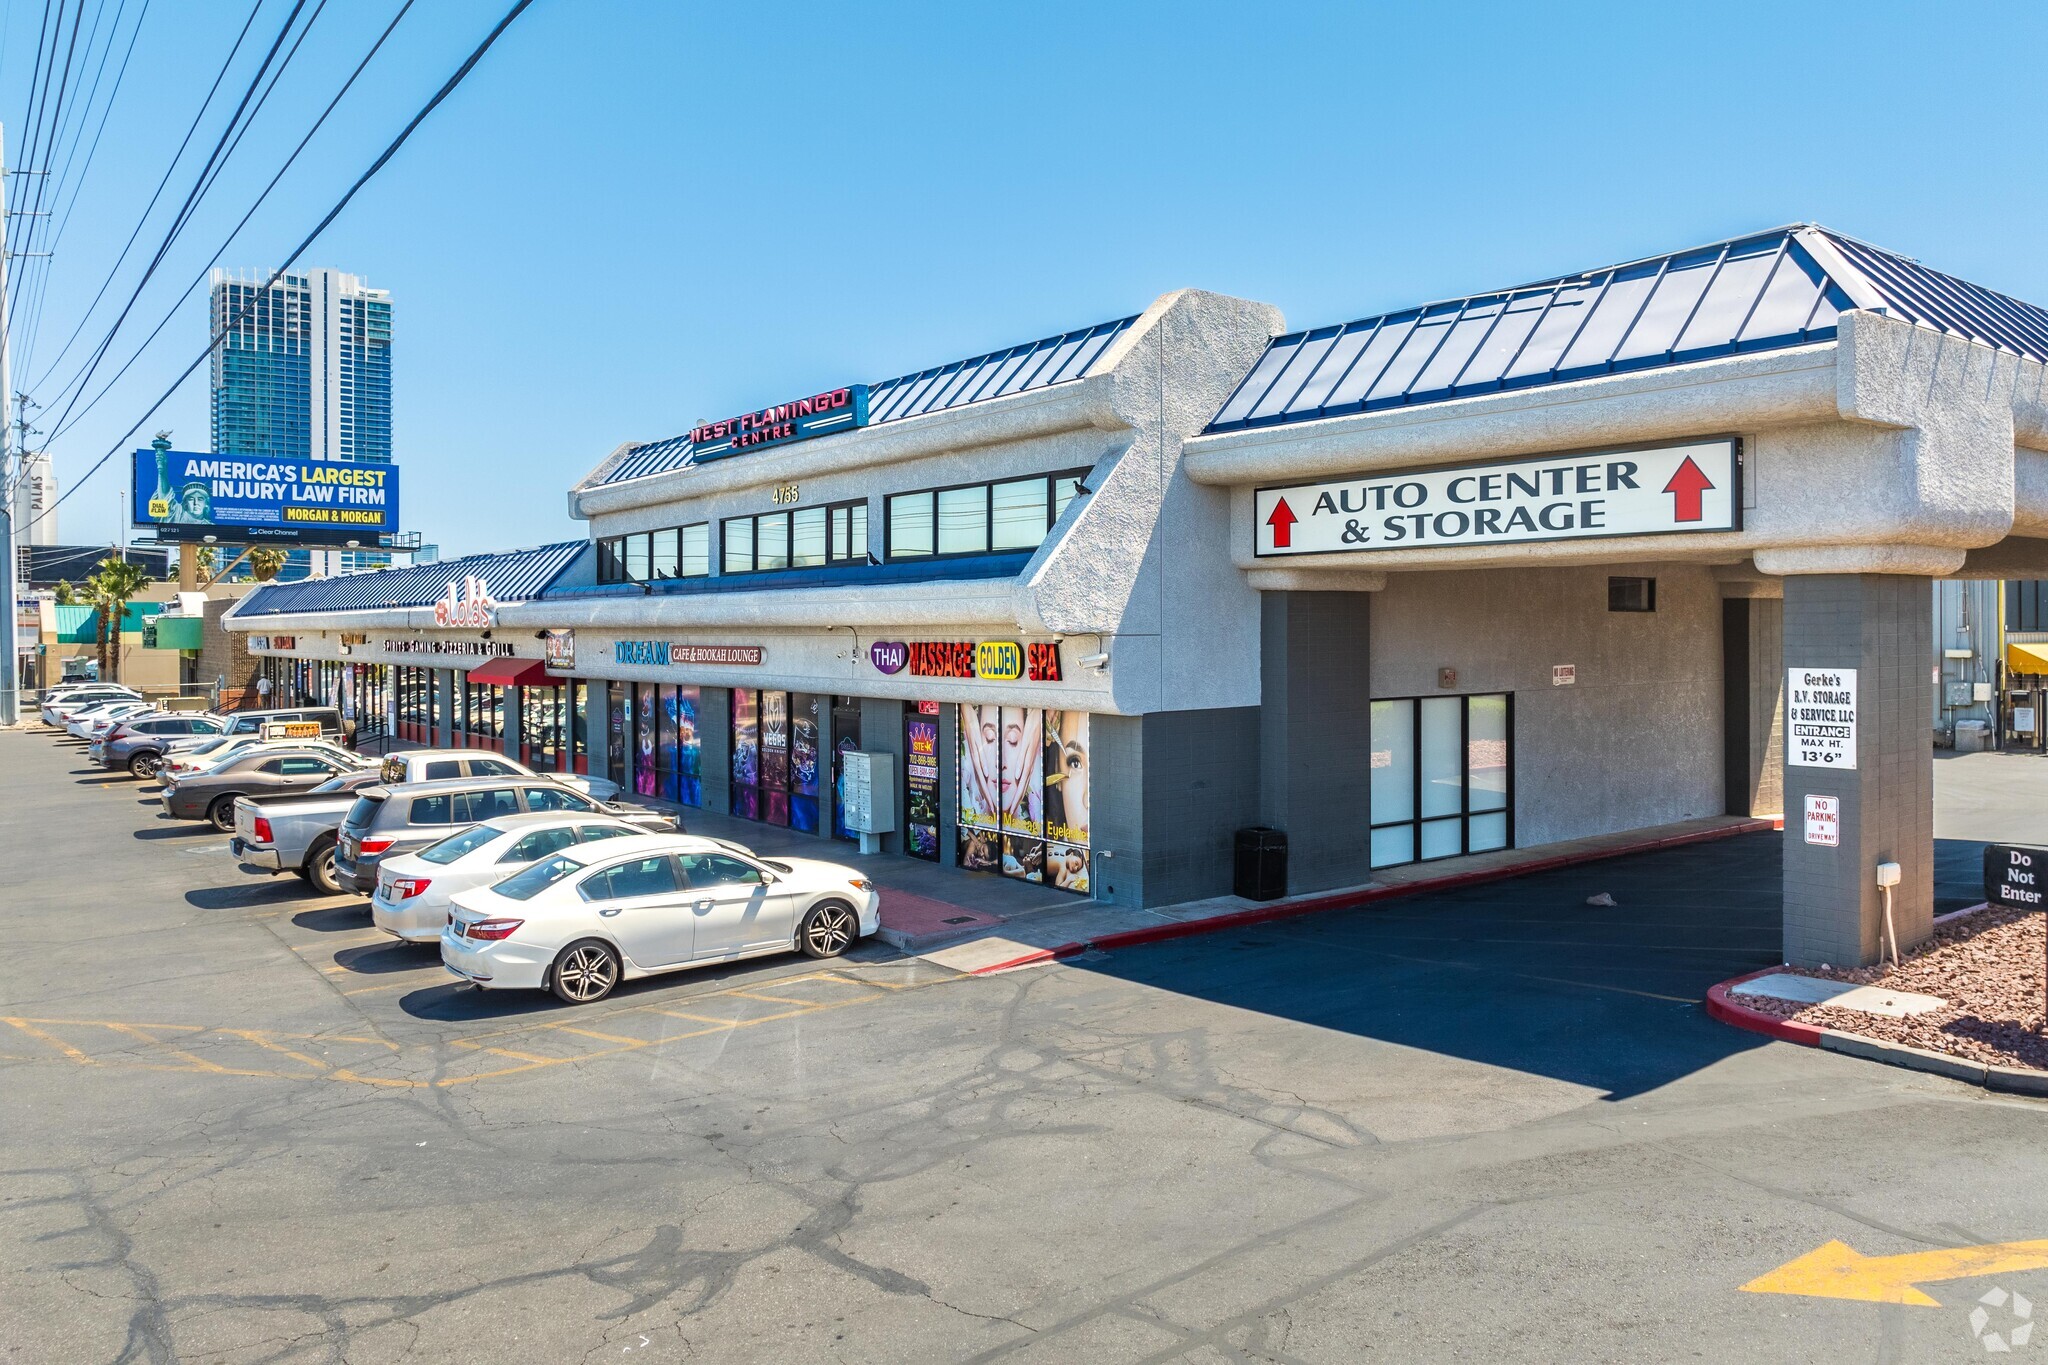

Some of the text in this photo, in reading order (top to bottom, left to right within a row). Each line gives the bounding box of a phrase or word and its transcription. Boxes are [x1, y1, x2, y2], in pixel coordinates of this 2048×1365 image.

[690, 388, 847, 443] WEST FLAMINGO
[731, 423, 791, 448] CENTRE
[184, 459, 386, 487] AMERICA'S LARGEST
[31, 476, 43, 510] PALMS
[212, 480, 385, 505] INJURY LAW FIRM
[1312, 461, 1641, 517] AUTO CENTER
[287, 508, 331, 521] MORGAN
[331, 511, 339, 522] &
[340, 511, 381, 523] MORGAN
[1341, 500, 1606, 544] & STORAGE
[383, 640, 405, 652] SPIRITS
[411, 640, 436, 653] GAMING
[442, 641, 475, 655] PIZZERIA
[486, 641, 510, 656] GRILL
[615, 641, 758, 665] DREAM CAFE & HOOKAH LOUNGE
[874, 642, 1059, 681] THAI MASSAGE GOLDEN SPA
[1804, 673, 1841, 686] Gerke's
[1794, 690, 1851, 704] R.V. STORAGE
[1791, 708, 1855, 723] & SERVICE LLC
[1795, 725, 1850, 737] ENTRANCE
[763, 732, 787, 747] VEGAS
[1801, 739, 1843, 748] MAX HT.
[1815, 800, 1828, 810] NO
[1808, 811, 1836, 822] PARKING
[1808, 832, 1835, 841] DRIVEWAY
[2010, 850, 2032, 866] Do
[2008, 868, 2035, 885] Not
[2001, 884, 2042, 903] Enter
